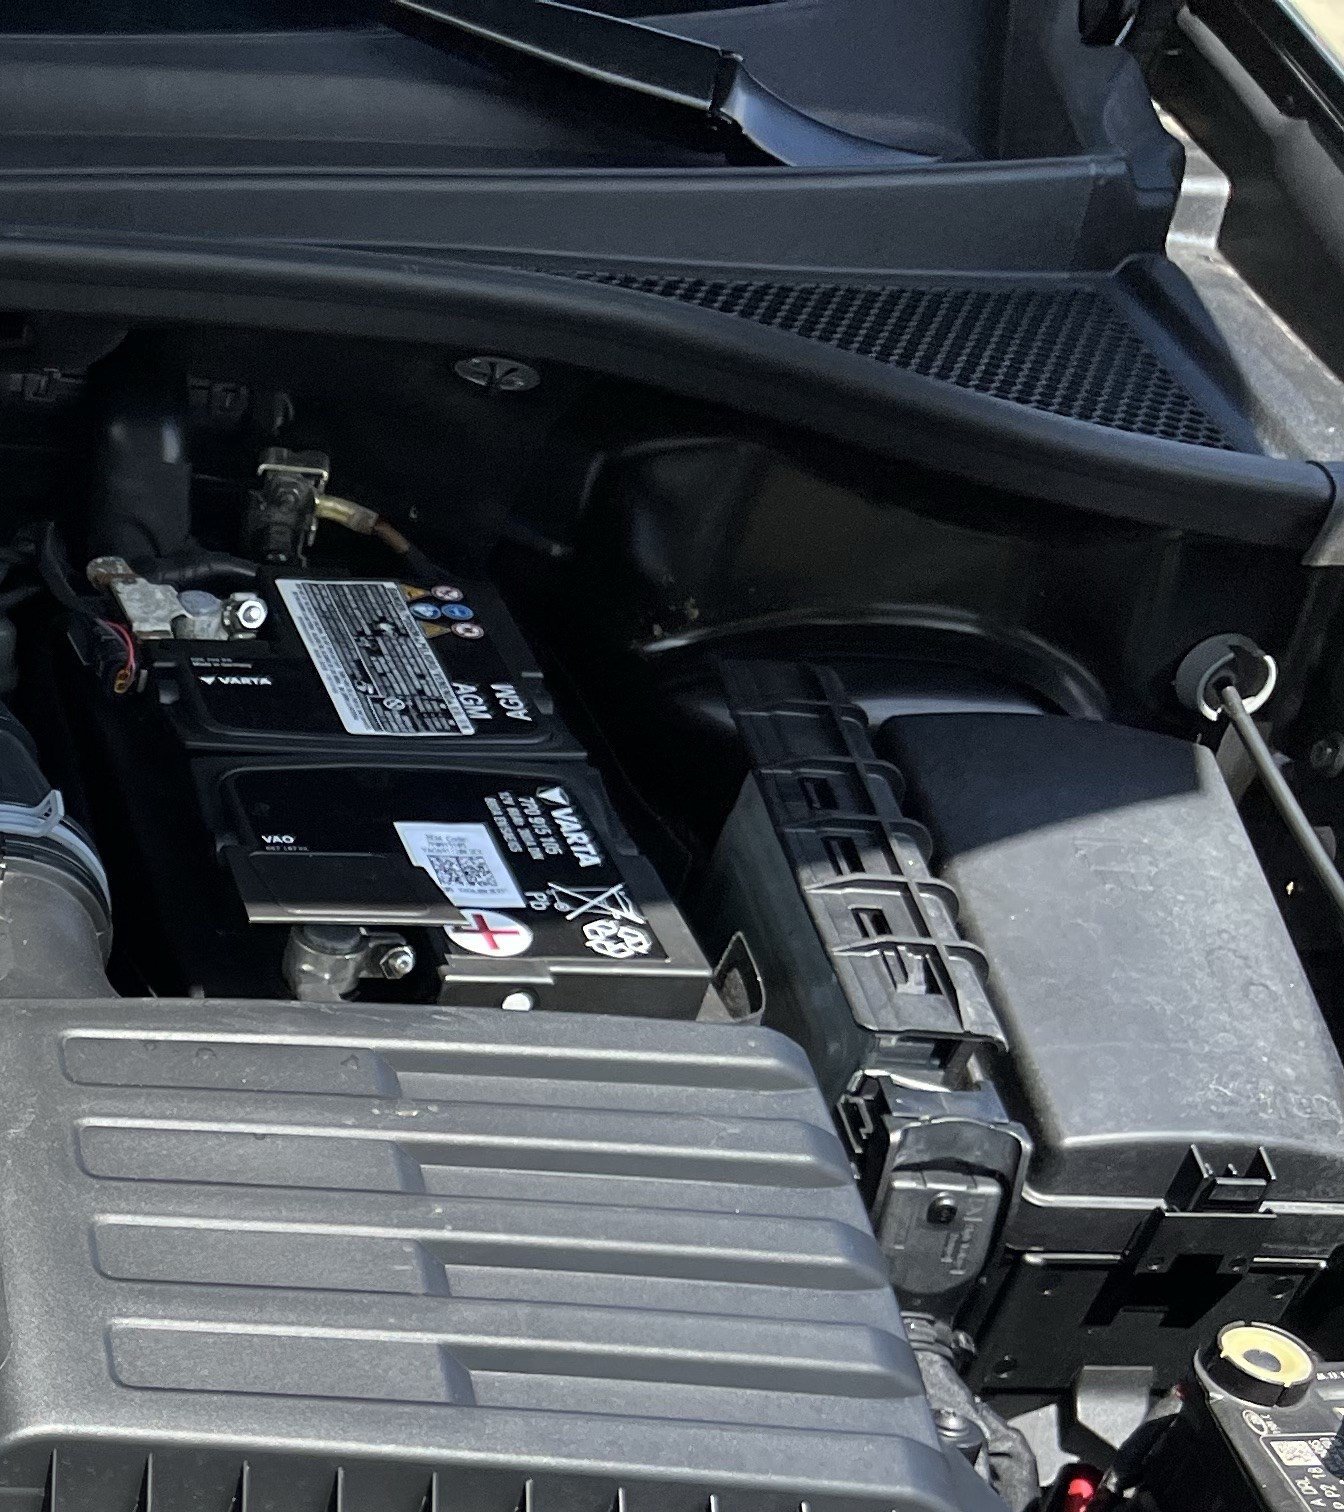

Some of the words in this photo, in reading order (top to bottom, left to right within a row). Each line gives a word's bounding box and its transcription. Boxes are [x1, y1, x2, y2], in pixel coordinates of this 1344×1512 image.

[217, 676, 272, 685] VARTA
[450, 682, 493, 720] AGM
[490, 683, 533, 722] AGM
[551, 806, 602, 867] VARTA
